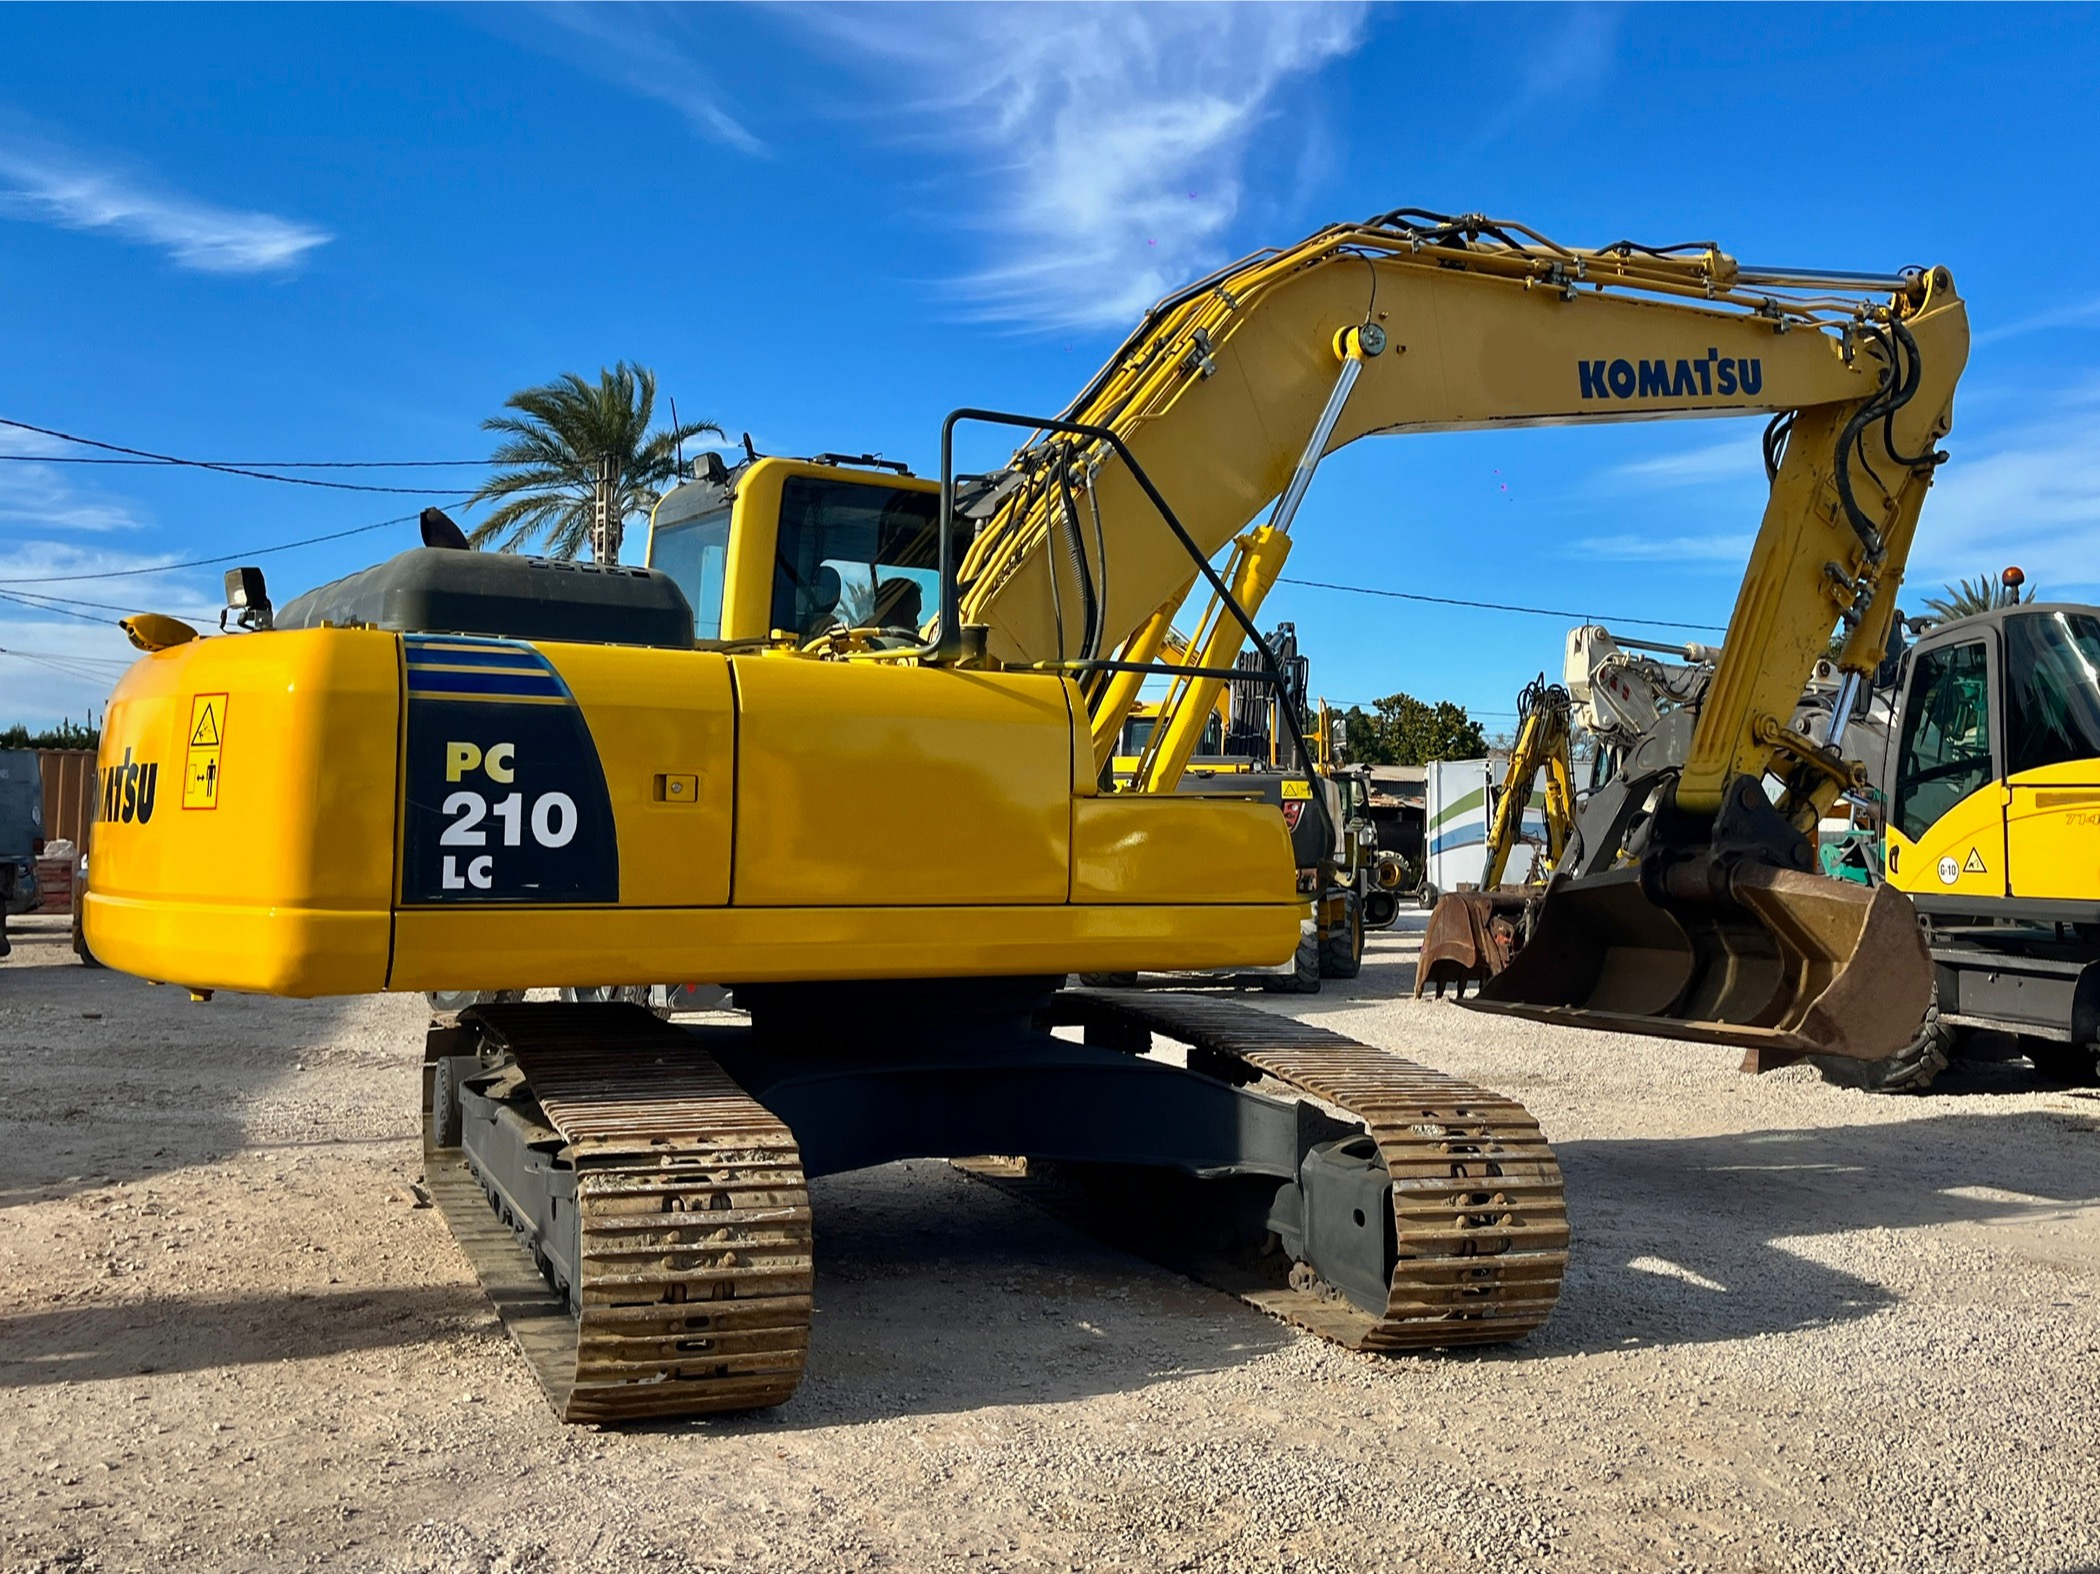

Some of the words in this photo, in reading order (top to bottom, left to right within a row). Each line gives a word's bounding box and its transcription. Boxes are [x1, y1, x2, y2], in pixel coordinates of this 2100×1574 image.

[1578, 347, 1762, 399] KOMATSU
[446, 741, 515, 784] PC
[439, 791, 578, 848] 210
[442, 855, 493, 890] LC
